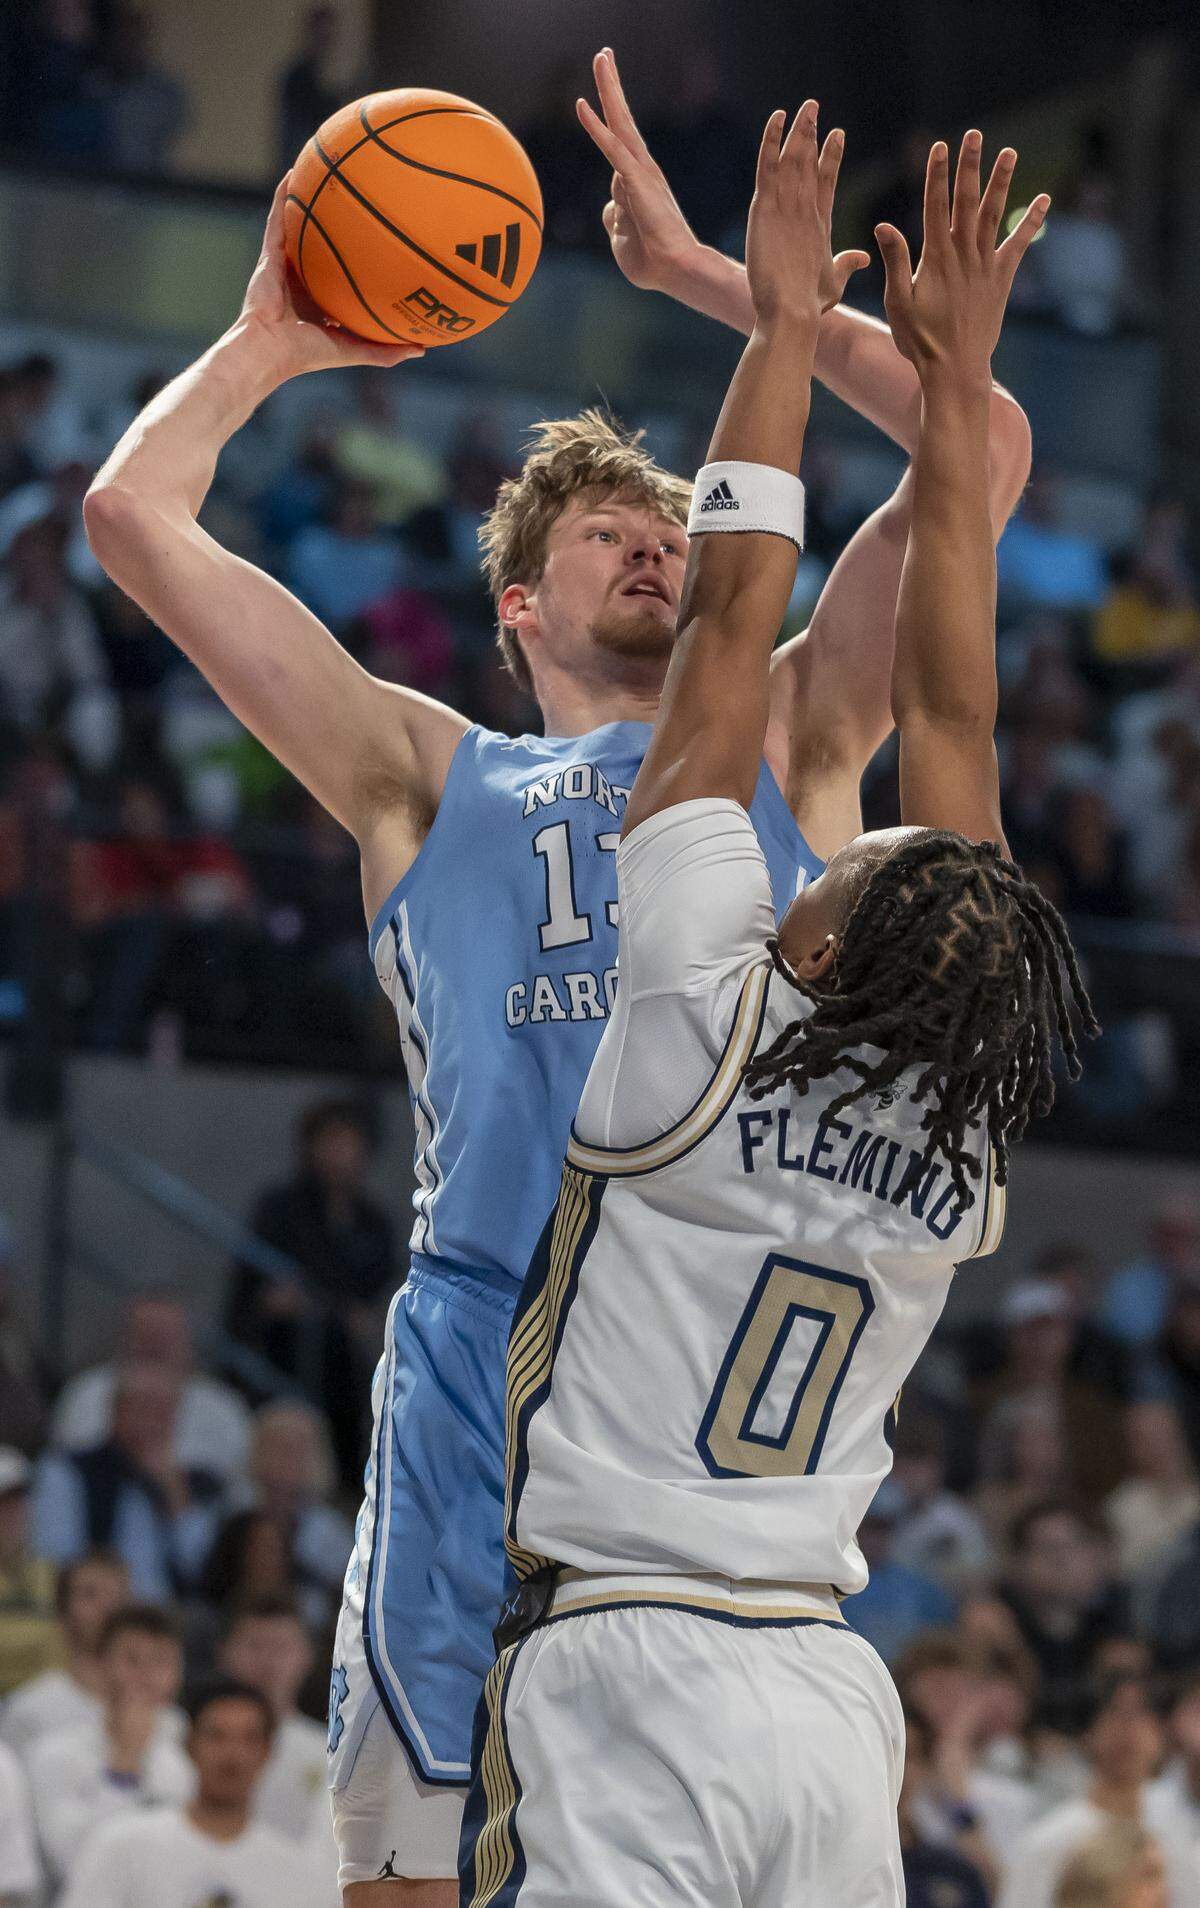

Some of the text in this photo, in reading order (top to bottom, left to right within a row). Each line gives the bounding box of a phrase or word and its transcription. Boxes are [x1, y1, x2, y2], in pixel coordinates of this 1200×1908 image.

[404, 286, 476, 333] PRO
[700, 499, 740, 512] adidas
[694, 1252, 876, 1479] 0
